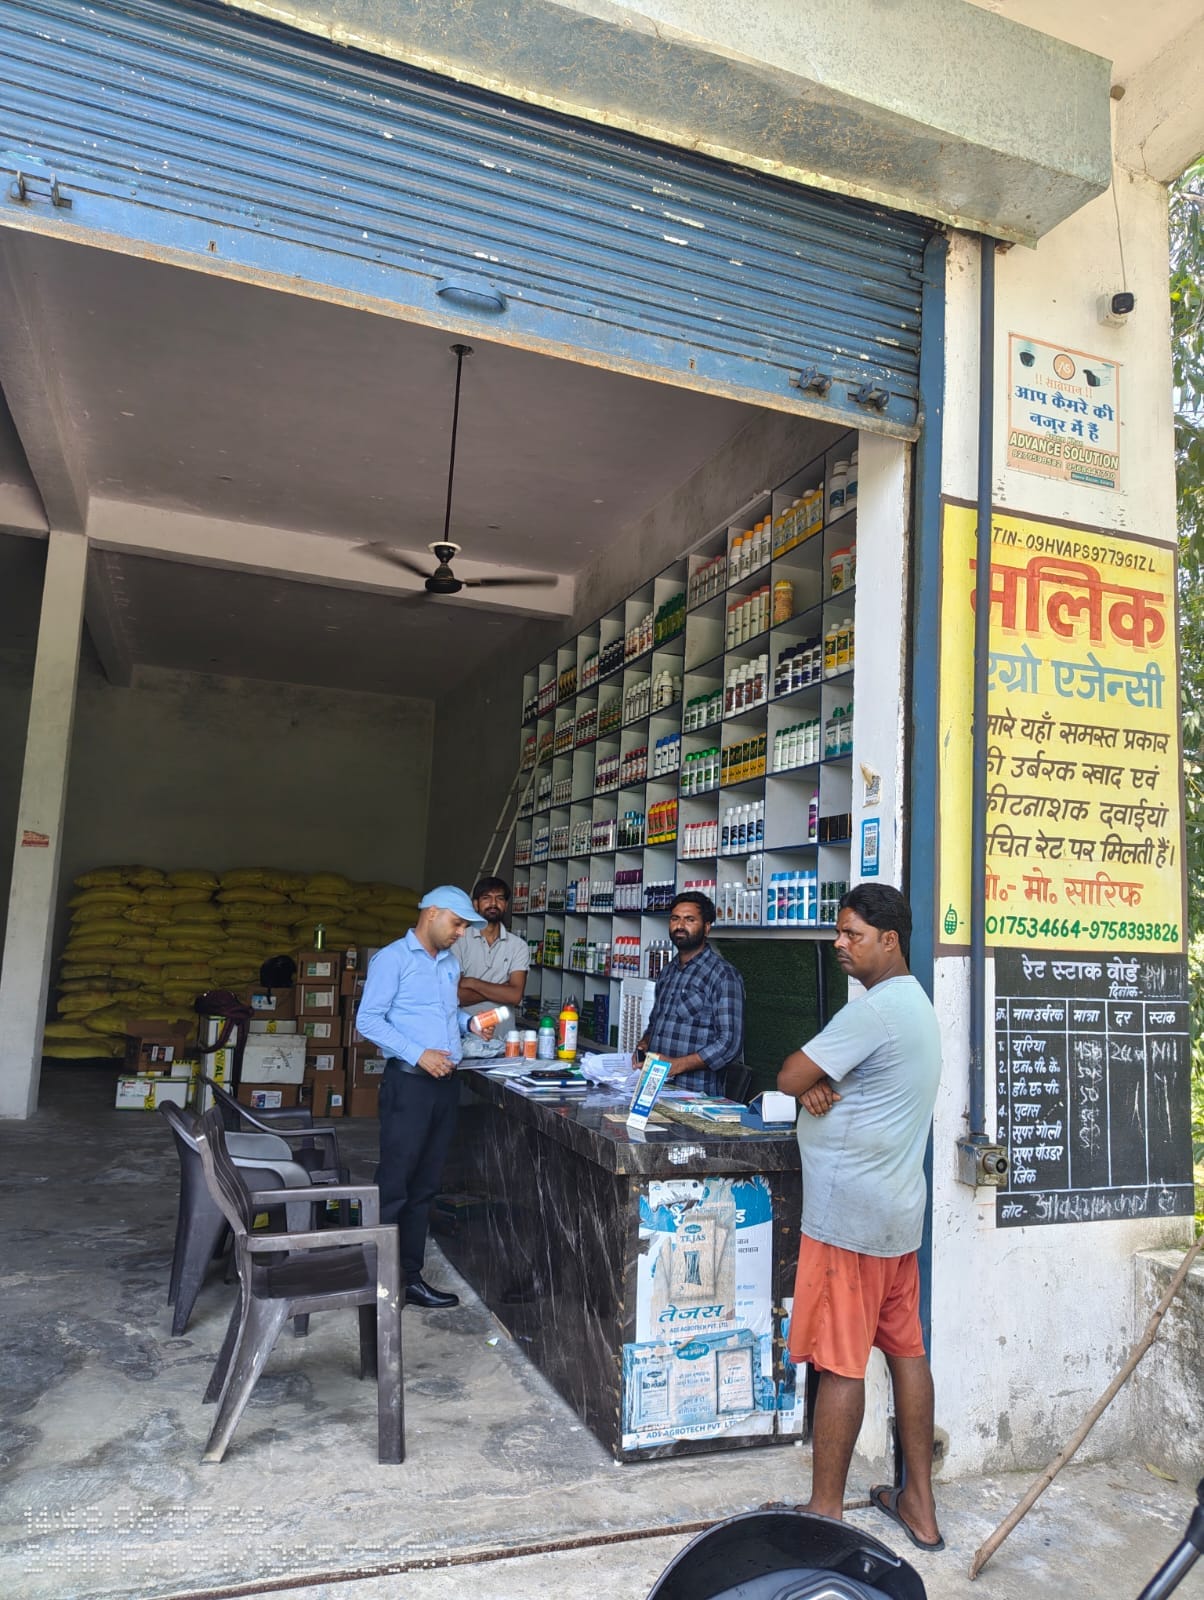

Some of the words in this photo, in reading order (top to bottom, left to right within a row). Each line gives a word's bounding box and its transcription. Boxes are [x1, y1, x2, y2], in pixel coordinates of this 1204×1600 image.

[1015, 385, 1048, 405] आप
[1051, 391, 1089, 415] कैमरे
[1092, 404, 1115, 422] की
[1070, 418, 1084, 437] में
[1087, 421, 1100, 443] हैं
[1008, 431, 1062, 458] ADVANCE
[1063, 444, 1119, 470] SOLUTION
[968, 555, 1166, 650] मालिक
[1051, 652, 1165, 709] एजेन्सी
[1020, 711, 1056, 744] यहाँ
[1059, 721, 1120, 748] समस्त
[1123, 727, 1171, 754] प्रकार
[1082, 762, 1125, 789] खाद
[1130, 765, 1160, 790] एवं
[1035, 829, 1066, 859] रेट
[1068, 838, 1097, 861] पर
[1100, 833, 1155, 865] मिलती
[985, 915, 1179, 943] 017534664-9758393826
[1021, 954, 1046, 981] रेट
[1051, 960, 1102, 981] स्टाक
[1013, 1008, 1034, 1021] नाम
[1073, 1009, 1100, 1023] मात्रा
[1114, 1010, 1133, 1027] दर
[1149, 1010, 1176, 1025] स्टाक
[1012, 1034, 1047, 1058] यूरिया
[1013, 1103, 1042, 1122] पुटास
[1012, 1125, 1035, 1144] सुपर
[1035, 1120, 1062, 1140] गोली
[1012, 1147, 1034, 1166] सुपर
[680, 1234, 707, 1244] TEJAS
[658, 1304, 725, 1323] तेजस
[663, 1425, 705, 1437] AGROTECH
